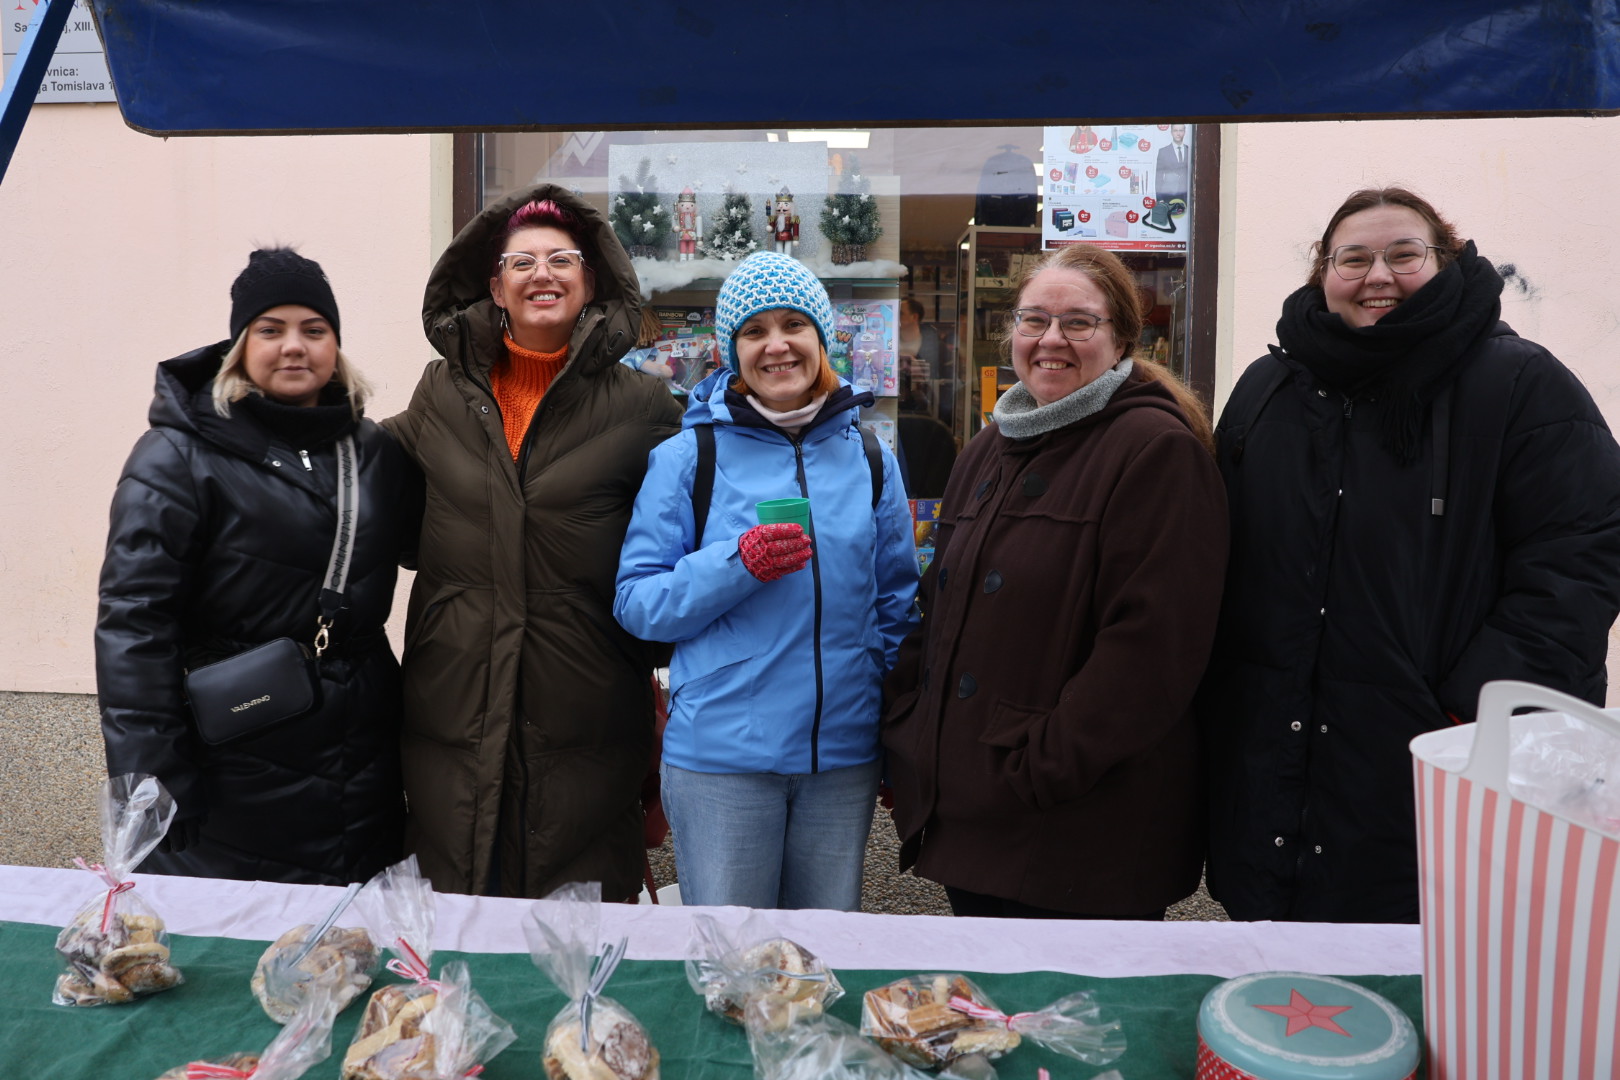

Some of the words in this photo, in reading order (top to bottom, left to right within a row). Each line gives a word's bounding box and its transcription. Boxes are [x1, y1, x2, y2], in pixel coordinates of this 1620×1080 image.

[74, 21, 94, 31] XIII.
[46, 66, 79, 77] vnica:
[50, 81, 105, 92] Tomislava
[340, 441, 353, 488] NTINO
[331, 509, 353, 588] VALENTINO
[230, 694, 271, 713] VALENTINO
